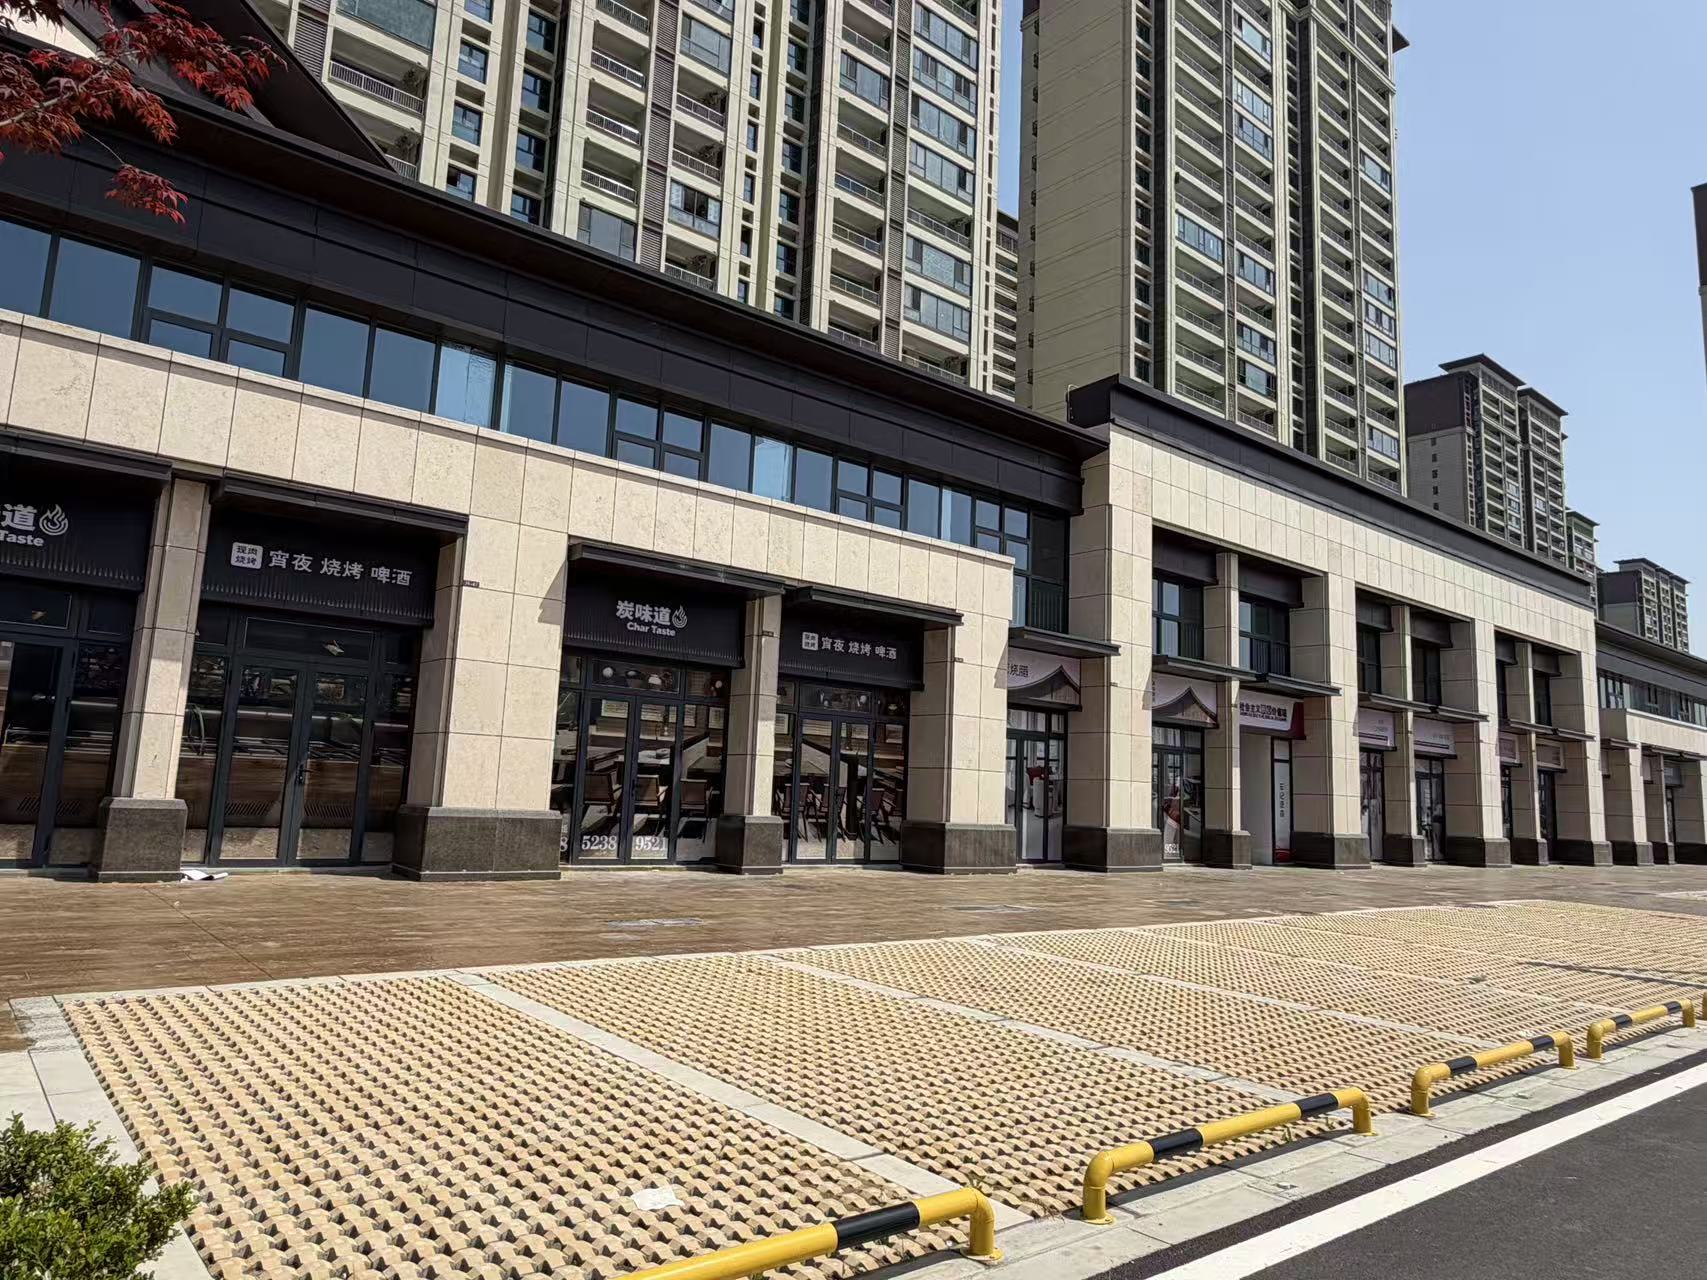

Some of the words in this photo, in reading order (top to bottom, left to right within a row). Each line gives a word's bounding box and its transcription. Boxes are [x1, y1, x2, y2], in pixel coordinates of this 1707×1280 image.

[1, 504, 37, 531] 道
[0, 530, 44, 546] Taste
[269, 550, 313, 572] 宵夜
[320, 558, 364, 580] 烧烤
[371, 566, 412, 586] 啤酒
[616, 600, 671, 625] 炭味道
[627, 621, 650, 633] Char
[651, 625, 676, 637] Taste
[848, 641, 871, 656] 烧烤
[875, 645, 896, 659] 啤酒
[582, 835, 617, 850] 5238
[635, 835, 666, 851] 9521
